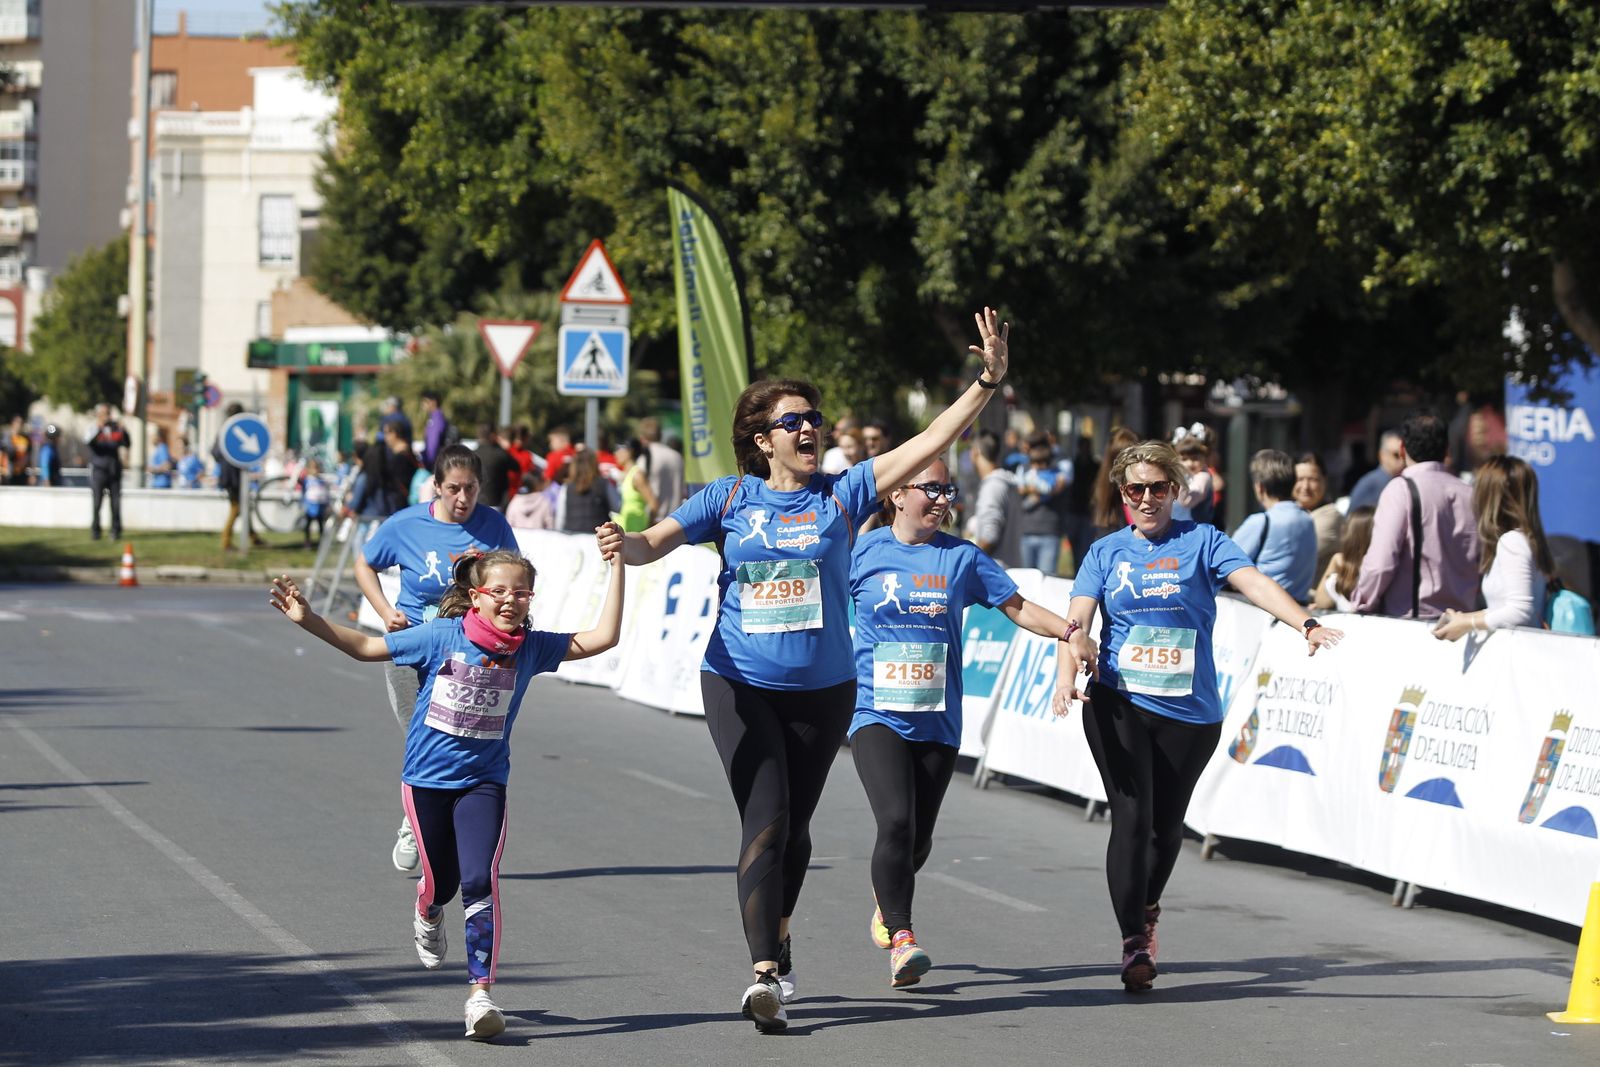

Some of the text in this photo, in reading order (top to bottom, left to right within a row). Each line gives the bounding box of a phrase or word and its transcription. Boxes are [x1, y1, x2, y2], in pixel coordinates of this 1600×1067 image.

[777, 524, 818, 533] CARRERA
[912, 575, 947, 589] VIII
[1142, 572, 1180, 580] CARRERA
[752, 579, 806, 600] 2298
[909, 591, 948, 599] CARRERA
[775, 597, 804, 606] PORTERO
[1131, 646, 1182, 665] 2159
[885, 663, 935, 680] 2158
[445, 682, 500, 707] 3263
[1557, 763, 1577, 791] DE
